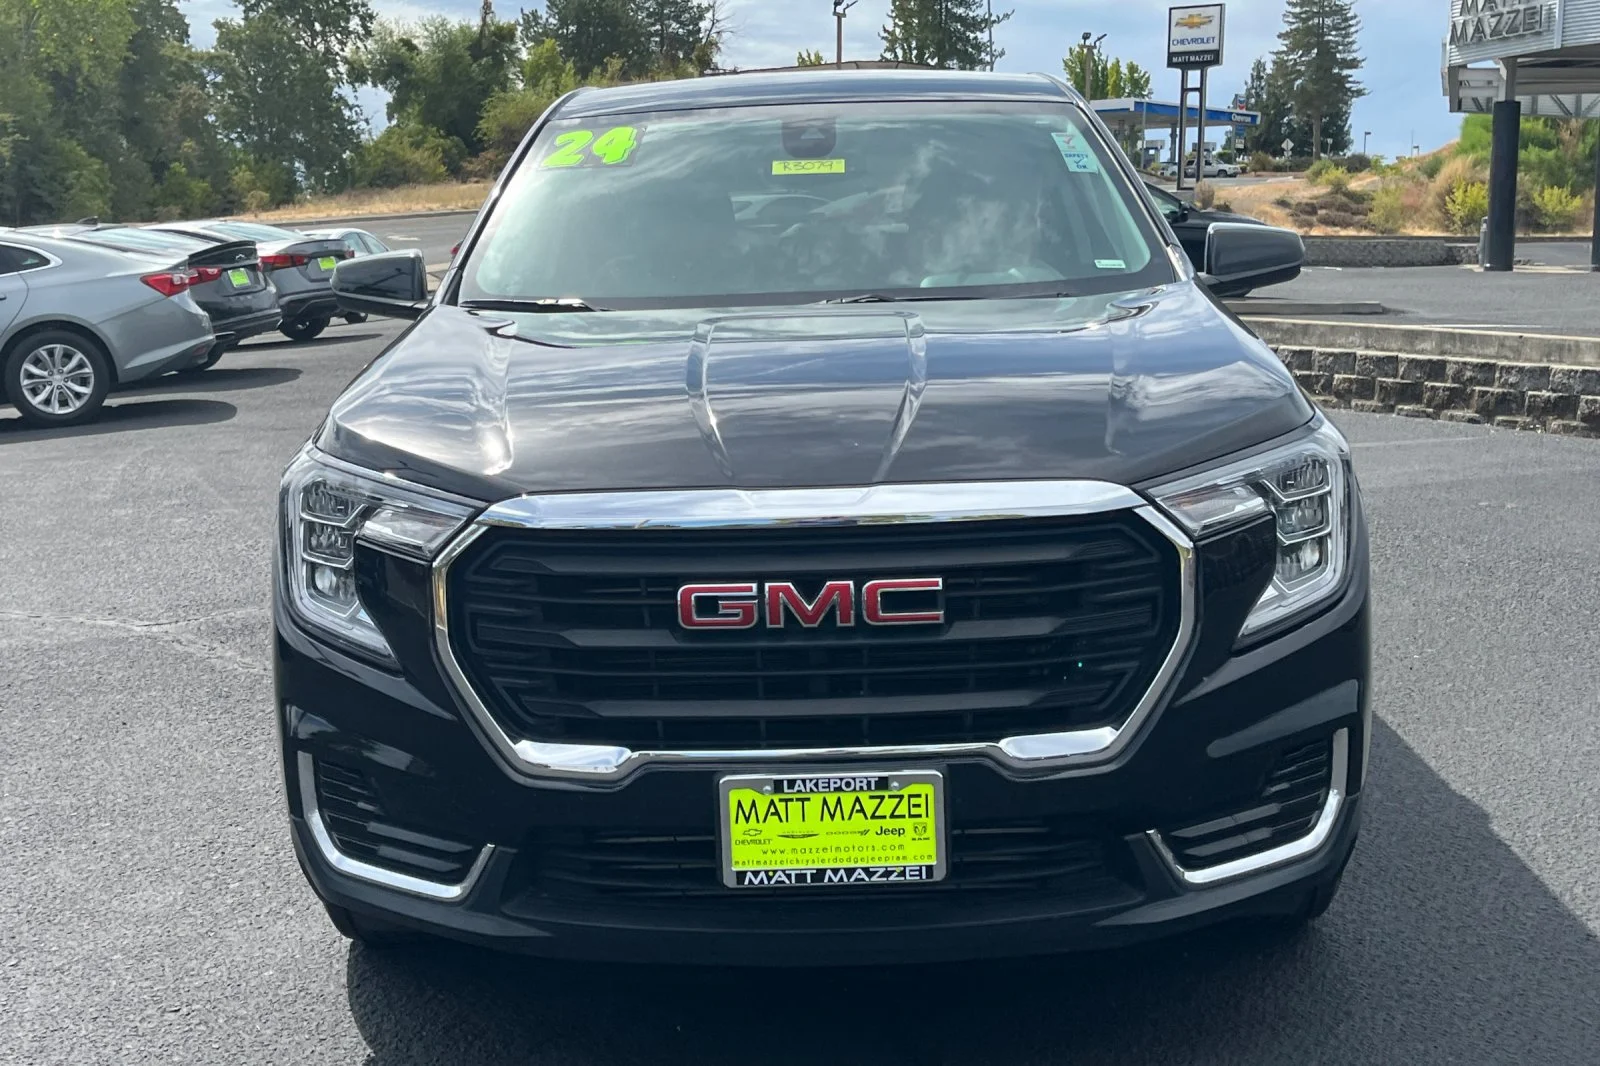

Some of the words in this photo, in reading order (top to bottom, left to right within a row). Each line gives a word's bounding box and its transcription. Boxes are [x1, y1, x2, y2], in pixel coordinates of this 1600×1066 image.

[1449, 4, 1543, 45] MAZZEI
[1172, 37, 1216, 46] CHEVROLET
[1172, 55, 1189, 63] MATT
[1189, 54, 1214, 62] MAZZEI
[541, 126, 637, 168] 24
[677, 577, 944, 629] GMC
[783, 777, 879, 793] LAKEPORT
[734, 797, 812, 824] MATT
[819, 793, 929, 822] MAZZEI
[875, 825, 906, 837] Jeep
[734, 838, 772, 846] CHEVROLET
[761, 844, 905, 856] www.mazzeimotors.com
[743, 869, 817, 885] MATT
[823, 866, 927, 883] MAZZEI
